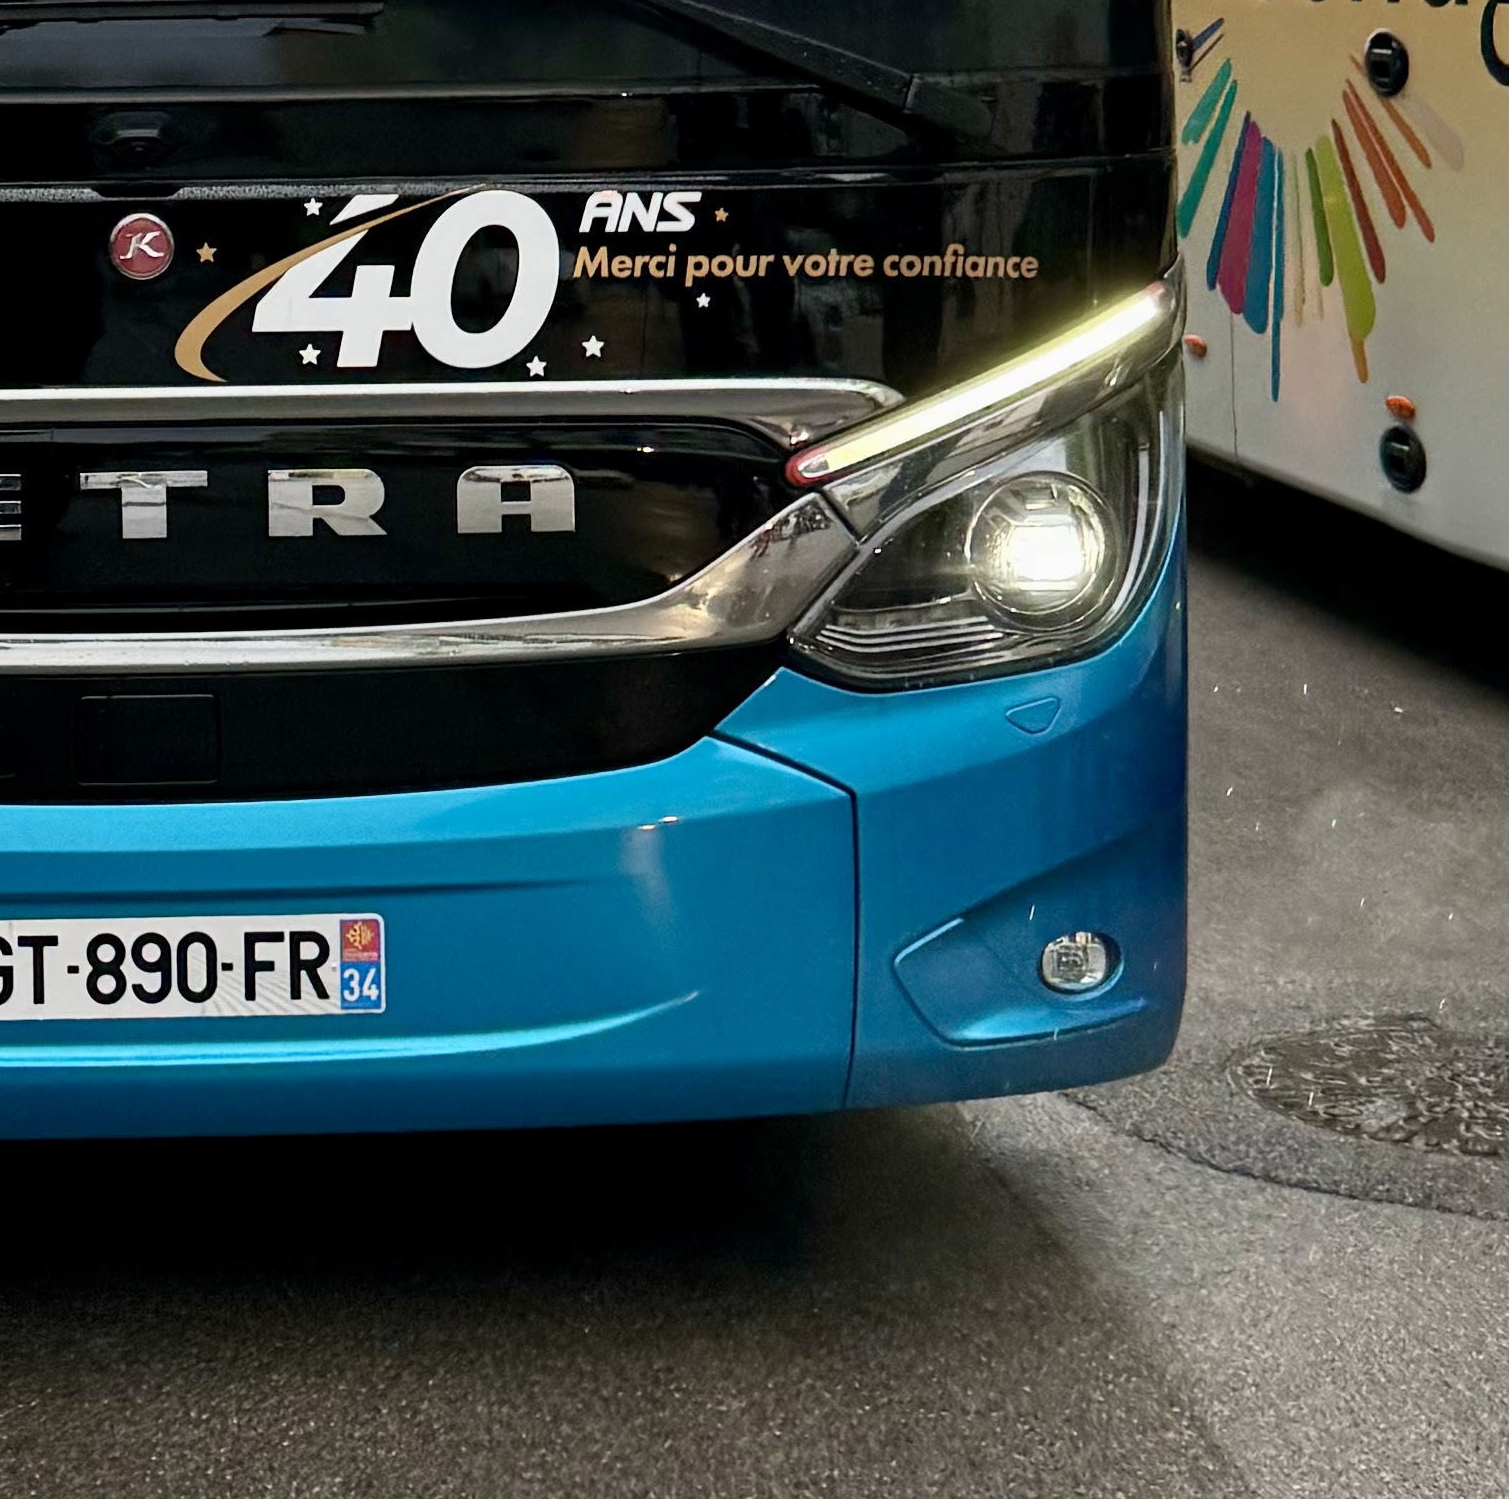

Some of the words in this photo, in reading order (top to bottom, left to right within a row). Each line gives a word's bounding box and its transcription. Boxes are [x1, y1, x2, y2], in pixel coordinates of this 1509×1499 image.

[578, 190, 702, 234] ANS
[251, 189, 560, 369] 40
[574, 245, 676, 280] Merci
[685, 252, 774, 288] pour
[782, 249, 874, 278] votre
[885, 249, 1040, 280] confiance
[342, 966, 380, 1002] 34
